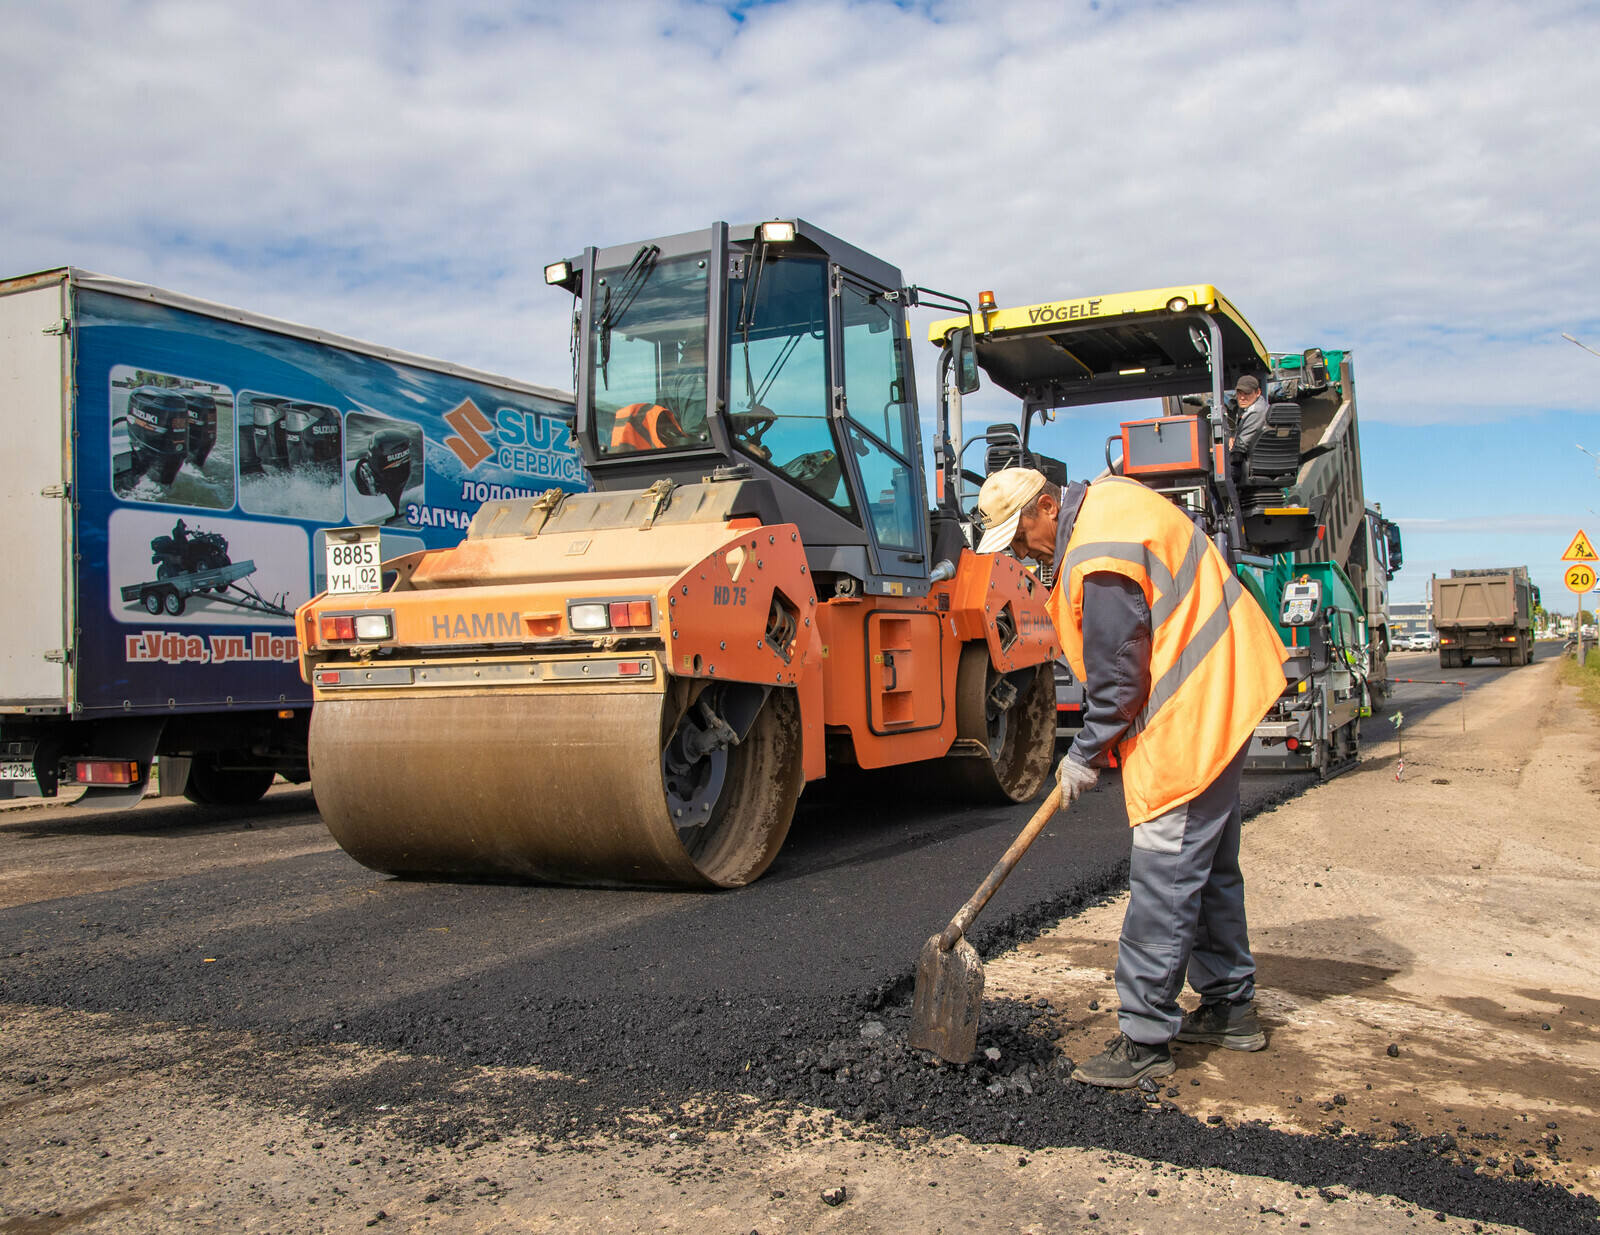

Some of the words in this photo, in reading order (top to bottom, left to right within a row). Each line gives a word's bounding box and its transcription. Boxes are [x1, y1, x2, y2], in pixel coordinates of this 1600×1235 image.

[1028, 301, 1100, 323] VÖGELE
[312, 425, 338, 436] SUZUKI
[407, 504, 479, 530] ЗАПЧА
[333, 544, 373, 566] 8885
[361, 568, 377, 583] 02
[1570, 573, 1590, 585] 20
[713, 585, 731, 606] HD
[733, 587, 747, 606] 75
[432, 611, 521, 639] HAMM
[212, 637, 250, 661] ул.
